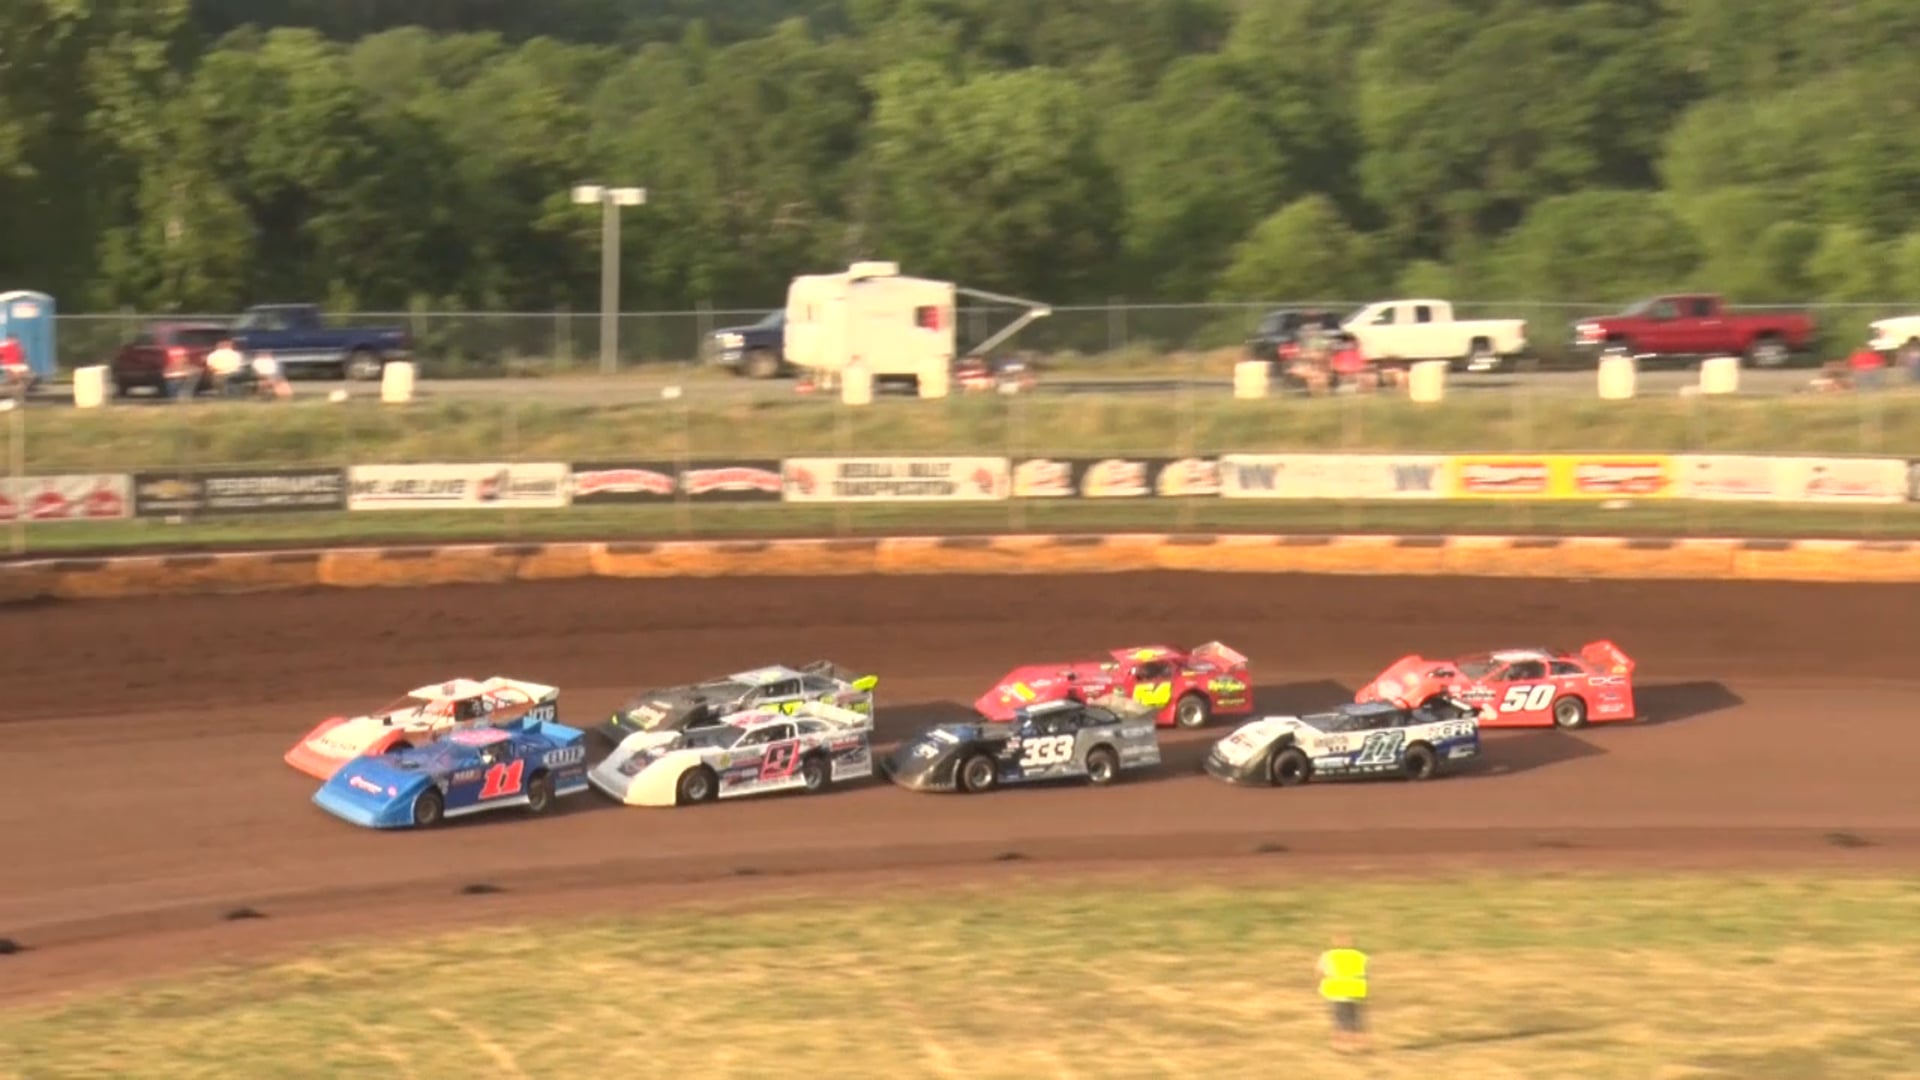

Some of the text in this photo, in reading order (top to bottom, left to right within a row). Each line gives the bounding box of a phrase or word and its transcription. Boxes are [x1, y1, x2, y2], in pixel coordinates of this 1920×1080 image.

[1500, 684, 1557, 713] 50
[1020, 735, 1075, 767] 333
[478, 758, 525, 800] 11
